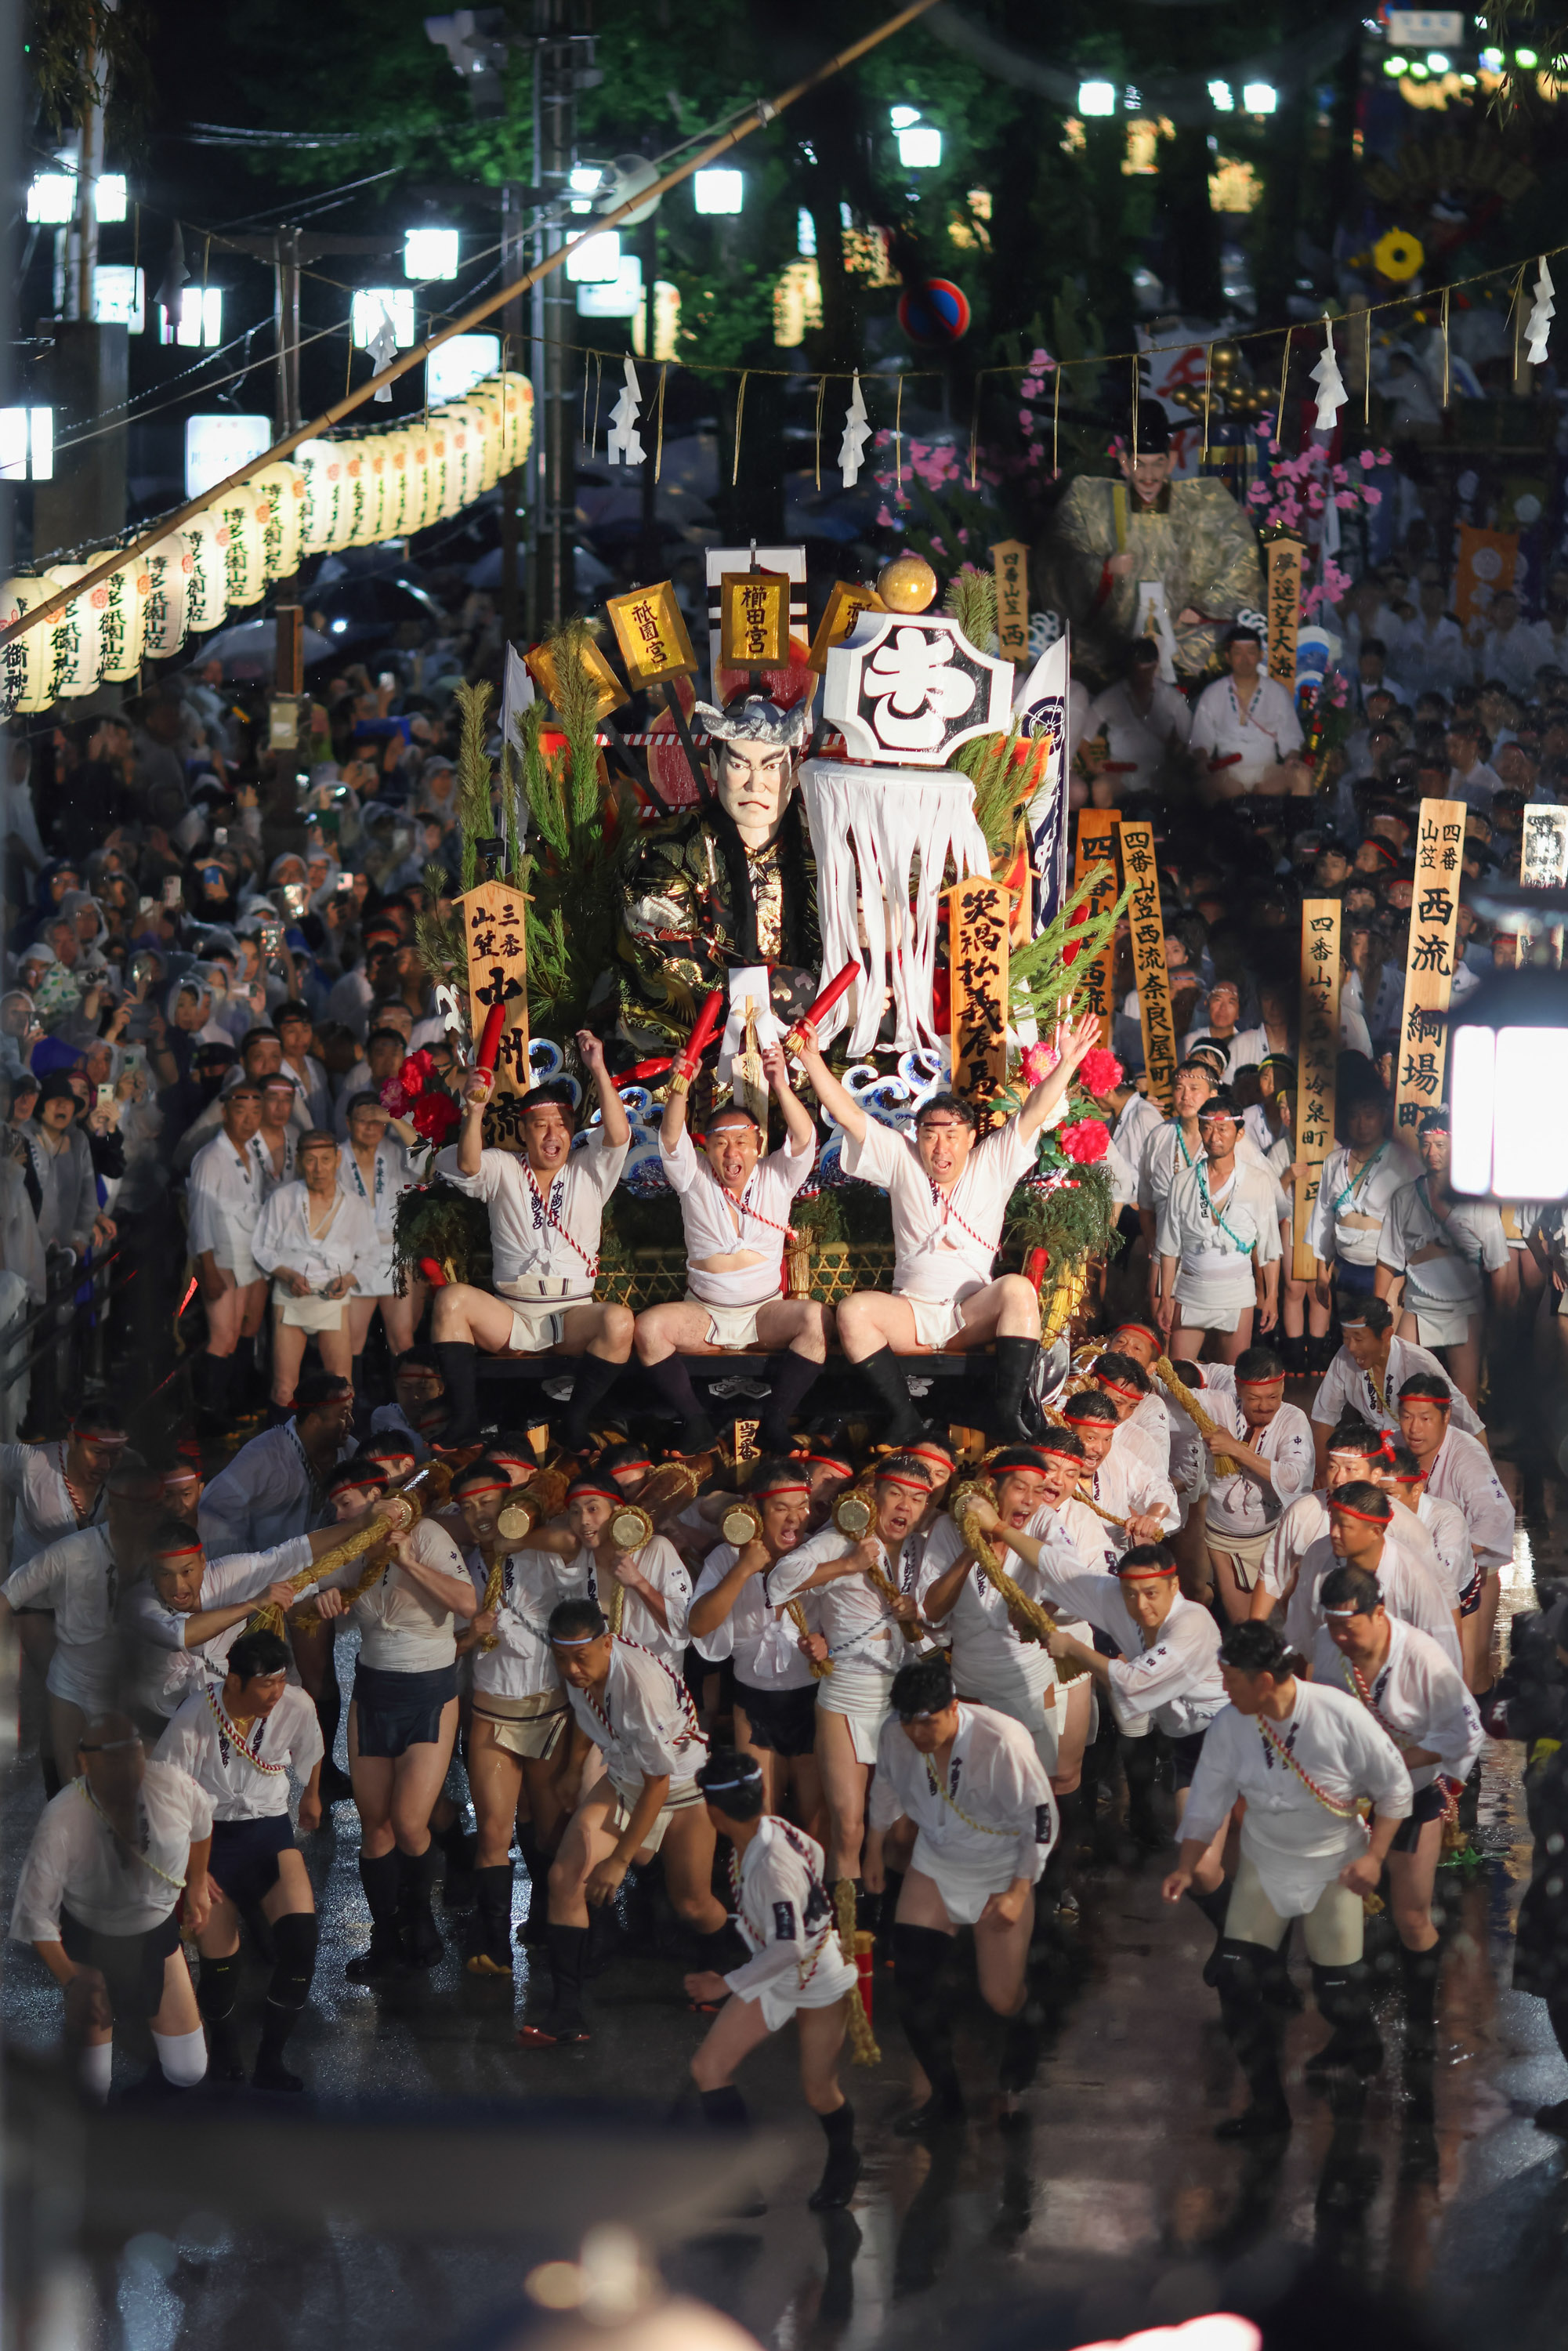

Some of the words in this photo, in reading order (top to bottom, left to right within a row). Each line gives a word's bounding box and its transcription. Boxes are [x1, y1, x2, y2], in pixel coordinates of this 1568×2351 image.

[632, 600, 668, 664] 祇園宮
[741, 585, 768, 654] 櫛田宮
[1001, 552, 1025, 665] 四番山笠西
[1419, 818, 1439, 869] 山笠
[1440, 824, 1461, 871] 四番
[472, 907, 500, 962] 山笠
[498, 904, 523, 958] 三番
[1410, 887, 1454, 976] 西流
[737, 1422, 757, 1460] 当番
[1294, 1436, 1302, 1454] 中一
